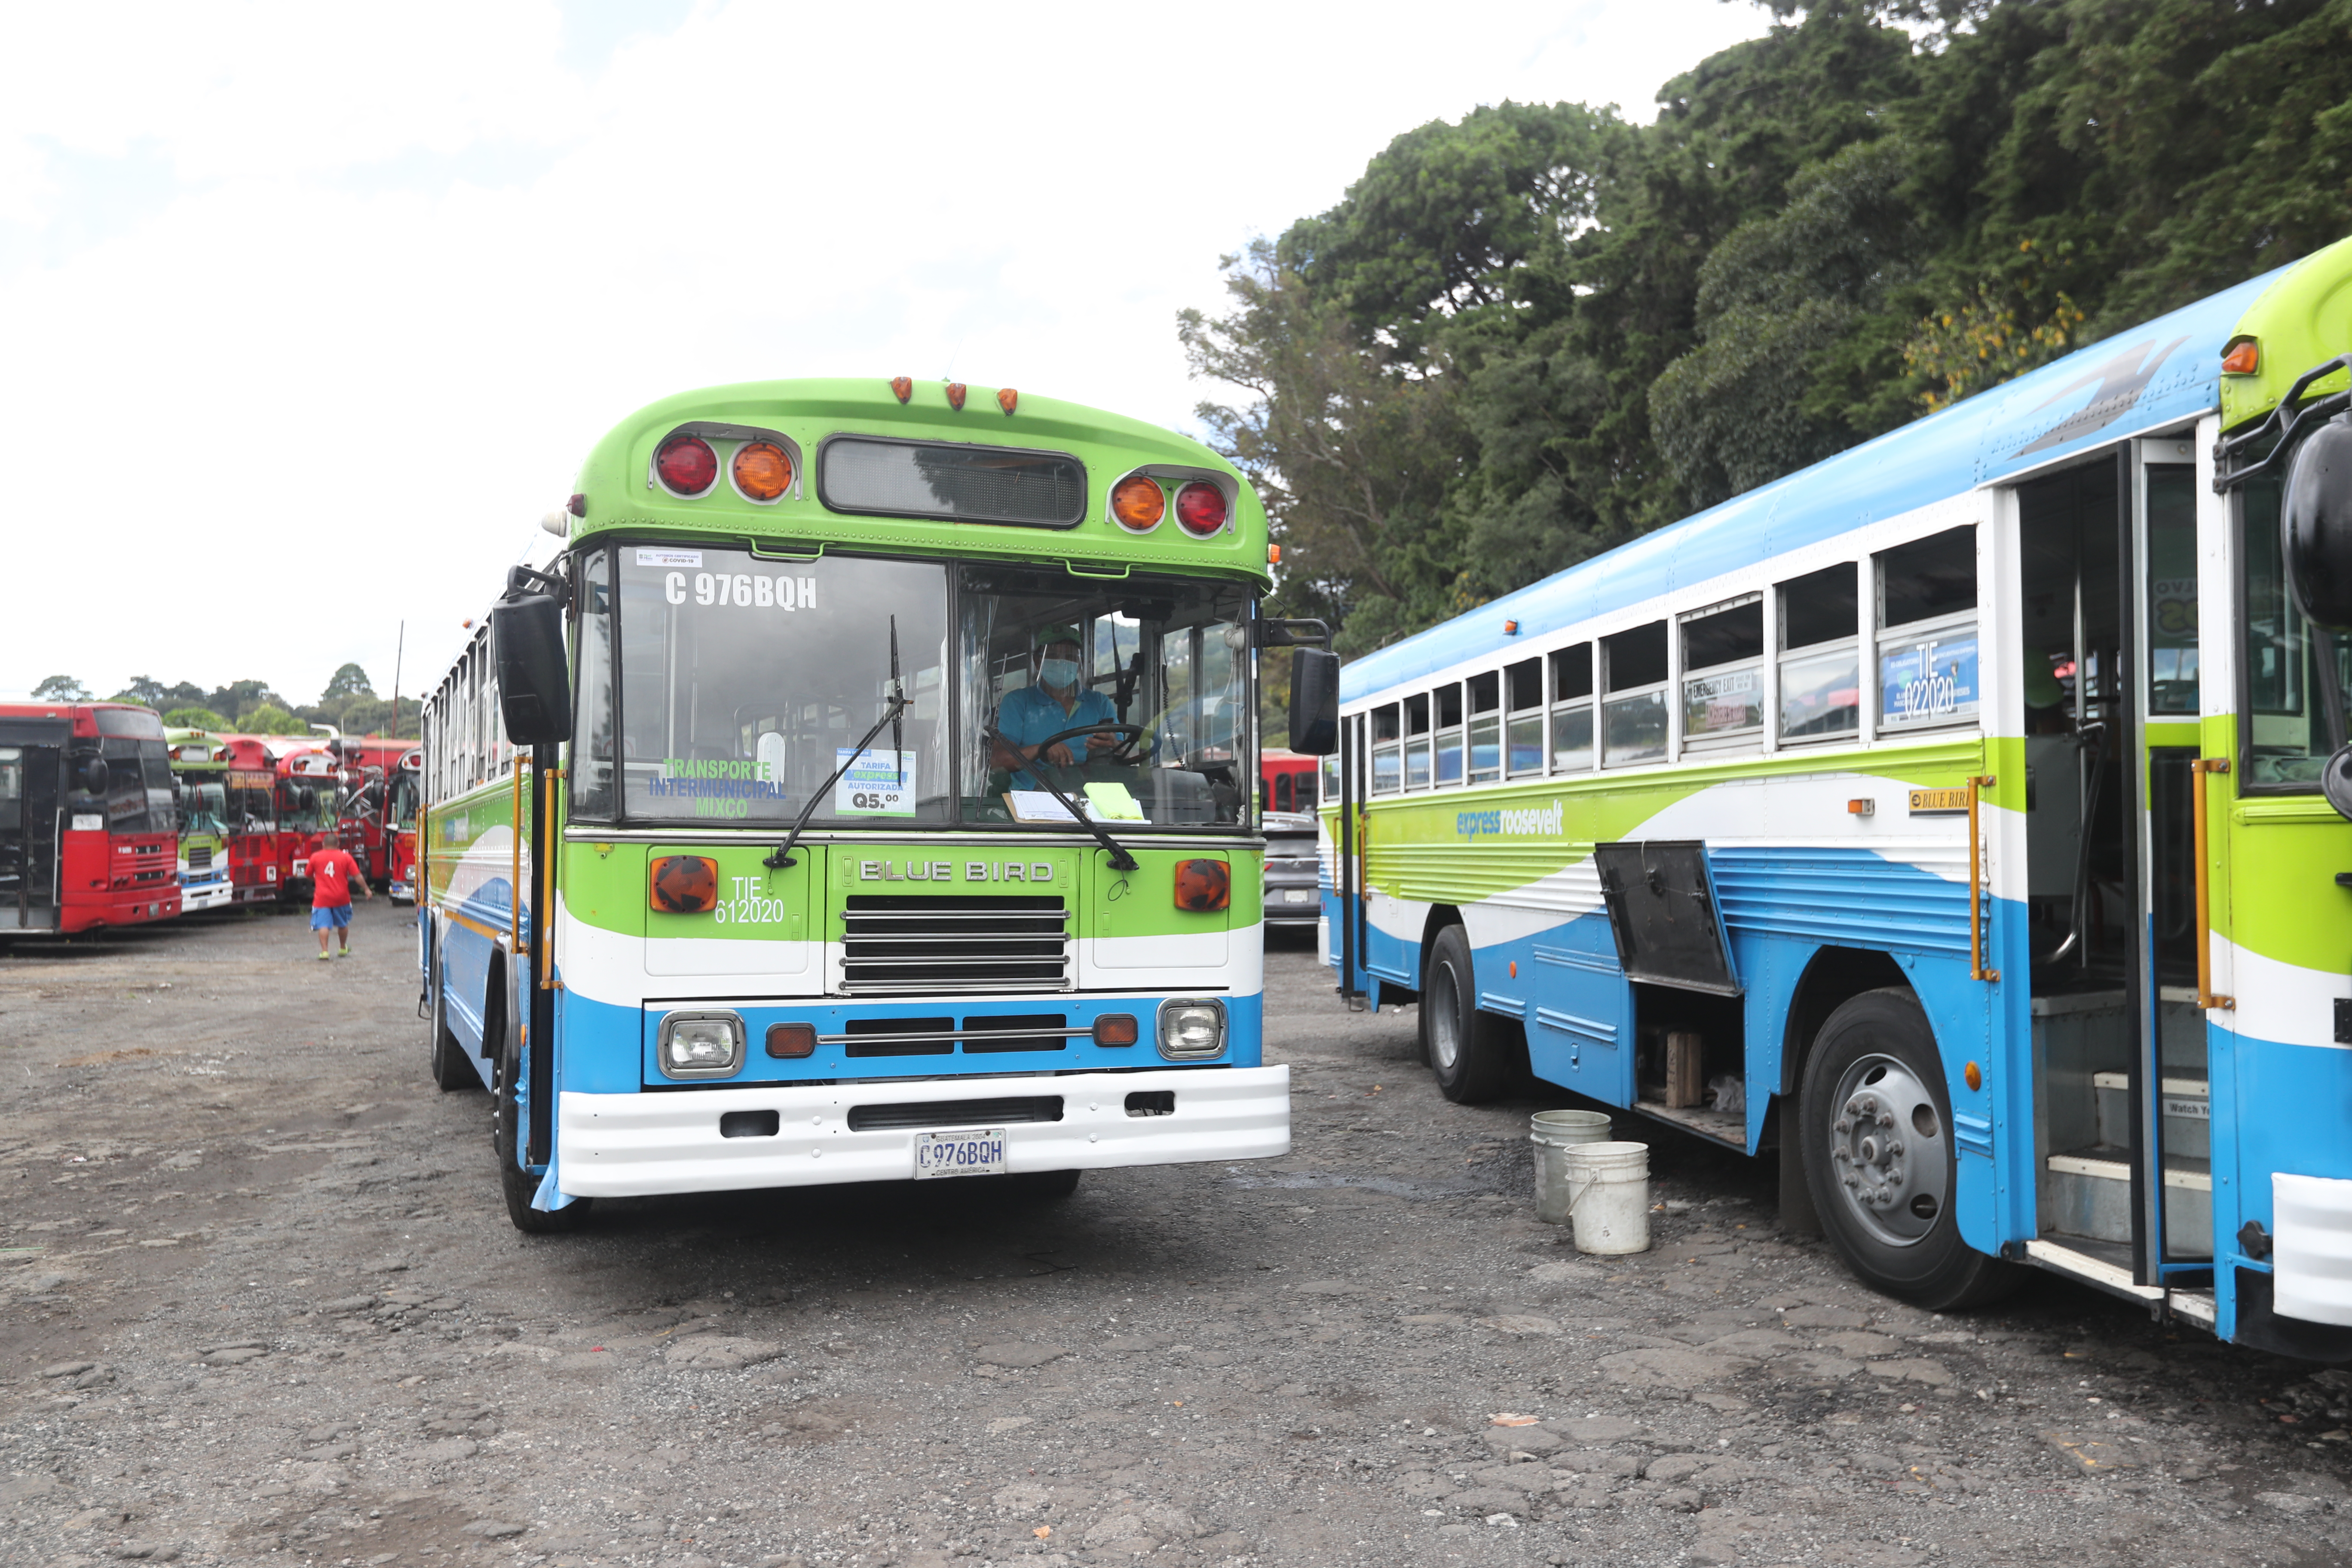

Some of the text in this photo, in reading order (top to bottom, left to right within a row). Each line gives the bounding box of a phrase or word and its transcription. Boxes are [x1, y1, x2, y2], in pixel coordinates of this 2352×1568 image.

[666, 572, 816, 612] C 976BQH
[1916, 641, 1939, 680] TIE
[1693, 679, 1721, 698] EMERGENCY
[1723, 677, 1734, 692] EXIT
[1905, 676, 1954, 717] 022020
[663, 758, 771, 780] TRANSPORTE
[854, 771, 899, 780] express
[649, 778, 786, 799] INTERMUNICIPAL
[848, 783, 903, 791] AUTORIZADA
[696, 797, 747, 818] MIXCO
[1923, 790, 1969, 808] BLUE BIR
[324, 861, 335, 878] 4
[860, 861, 1053, 882] BLUE BIRD
[732, 877, 762, 900] TIE
[715, 899, 784, 923] 612020
[2169, 1103, 2198, 1114] Watch
[936, 1133, 970, 1142] GUATEMALA
